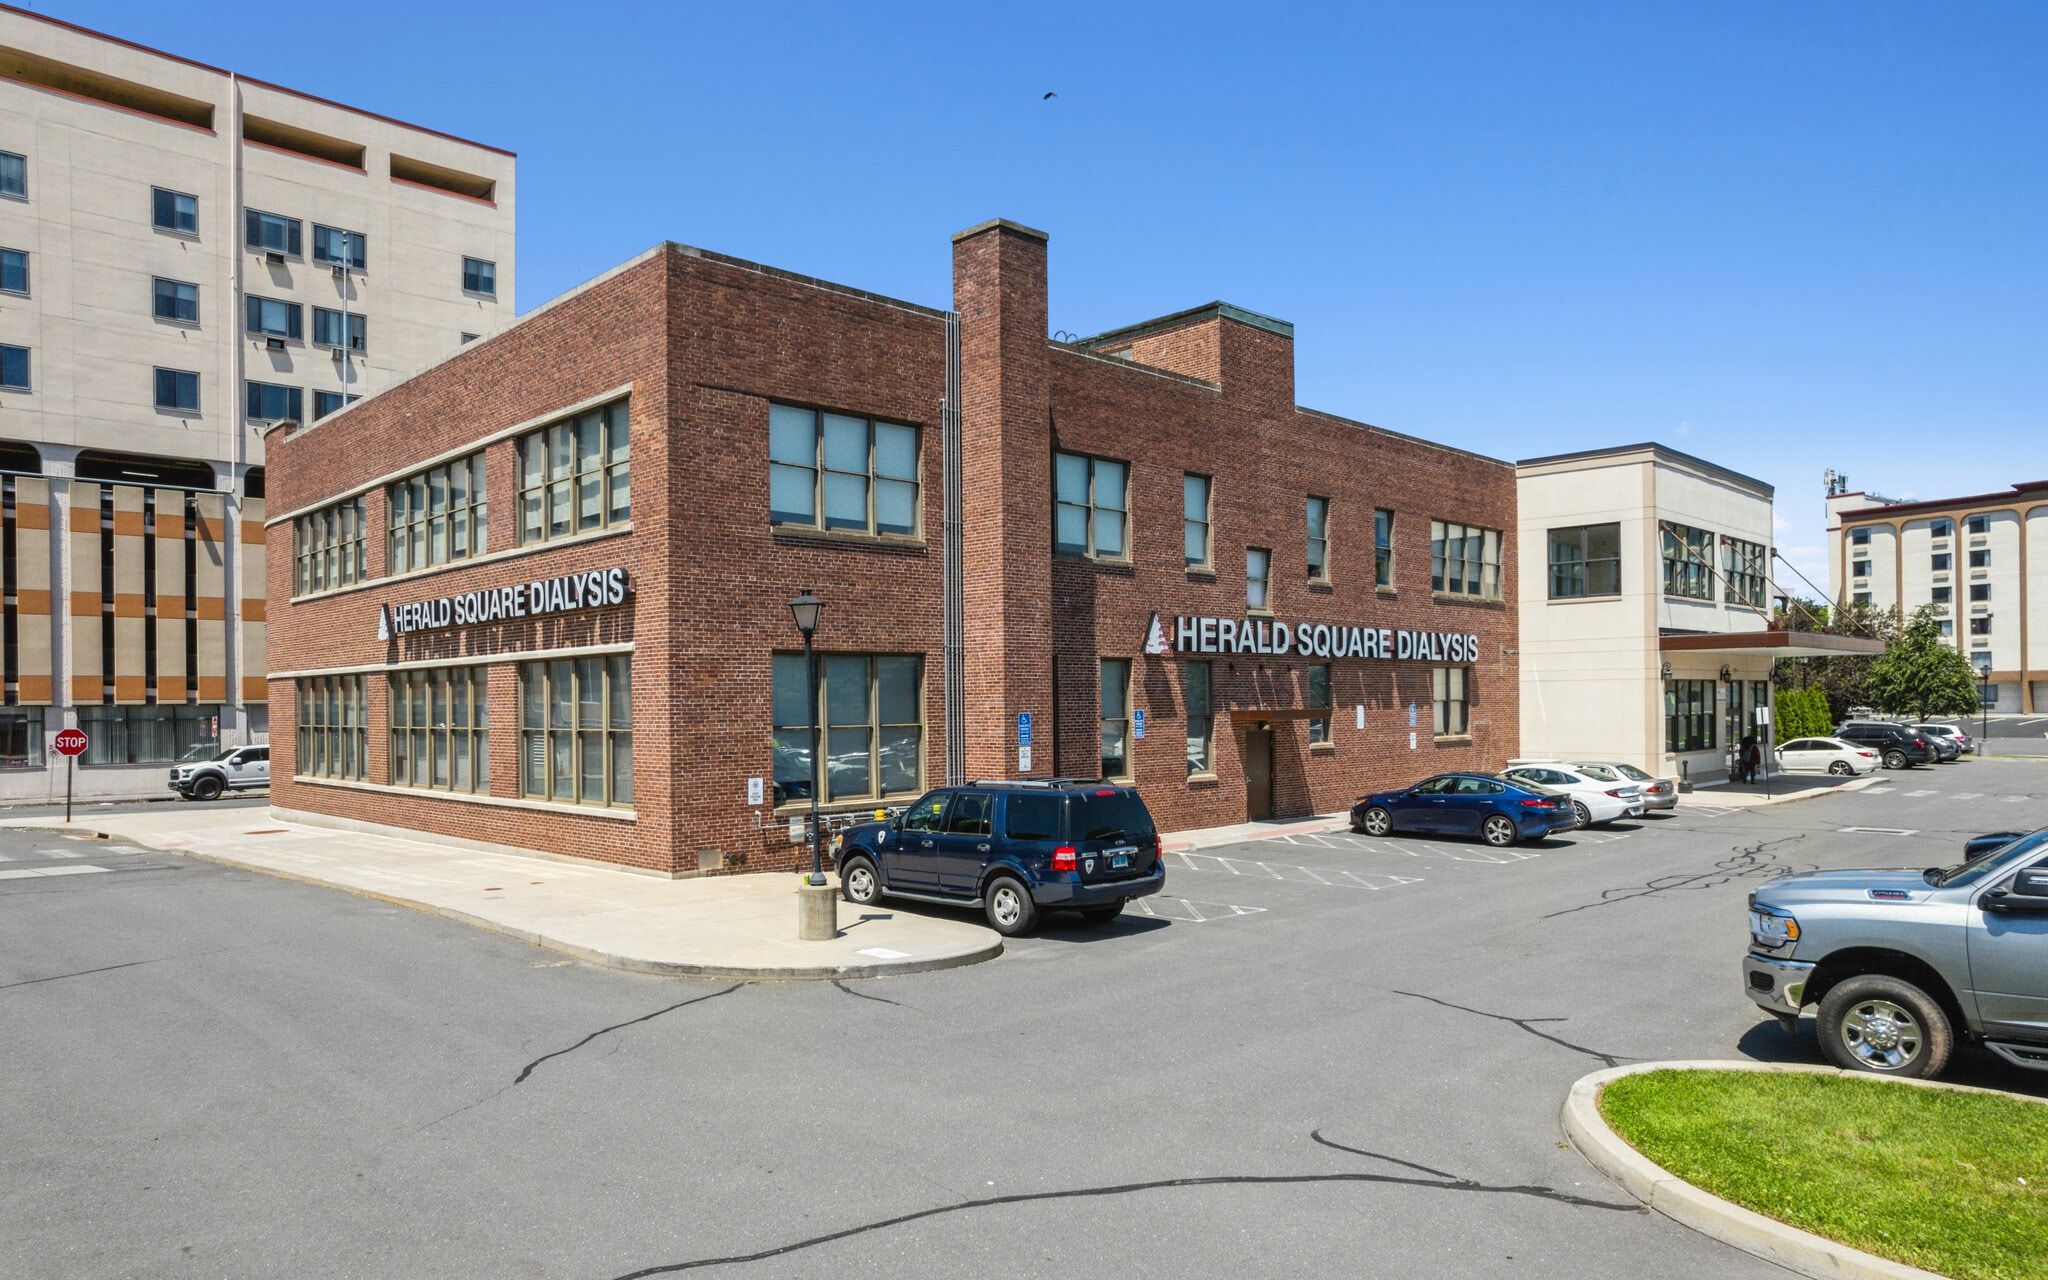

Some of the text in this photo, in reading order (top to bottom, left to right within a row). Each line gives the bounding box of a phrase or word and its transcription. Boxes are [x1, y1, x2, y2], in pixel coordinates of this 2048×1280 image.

[393, 568, 625, 633] HERALD SQUARE DIALYSIS
[1177, 616, 1479, 662] HERALD SQUARE DIALYSIS
[56, 737, 86, 748] STOP
